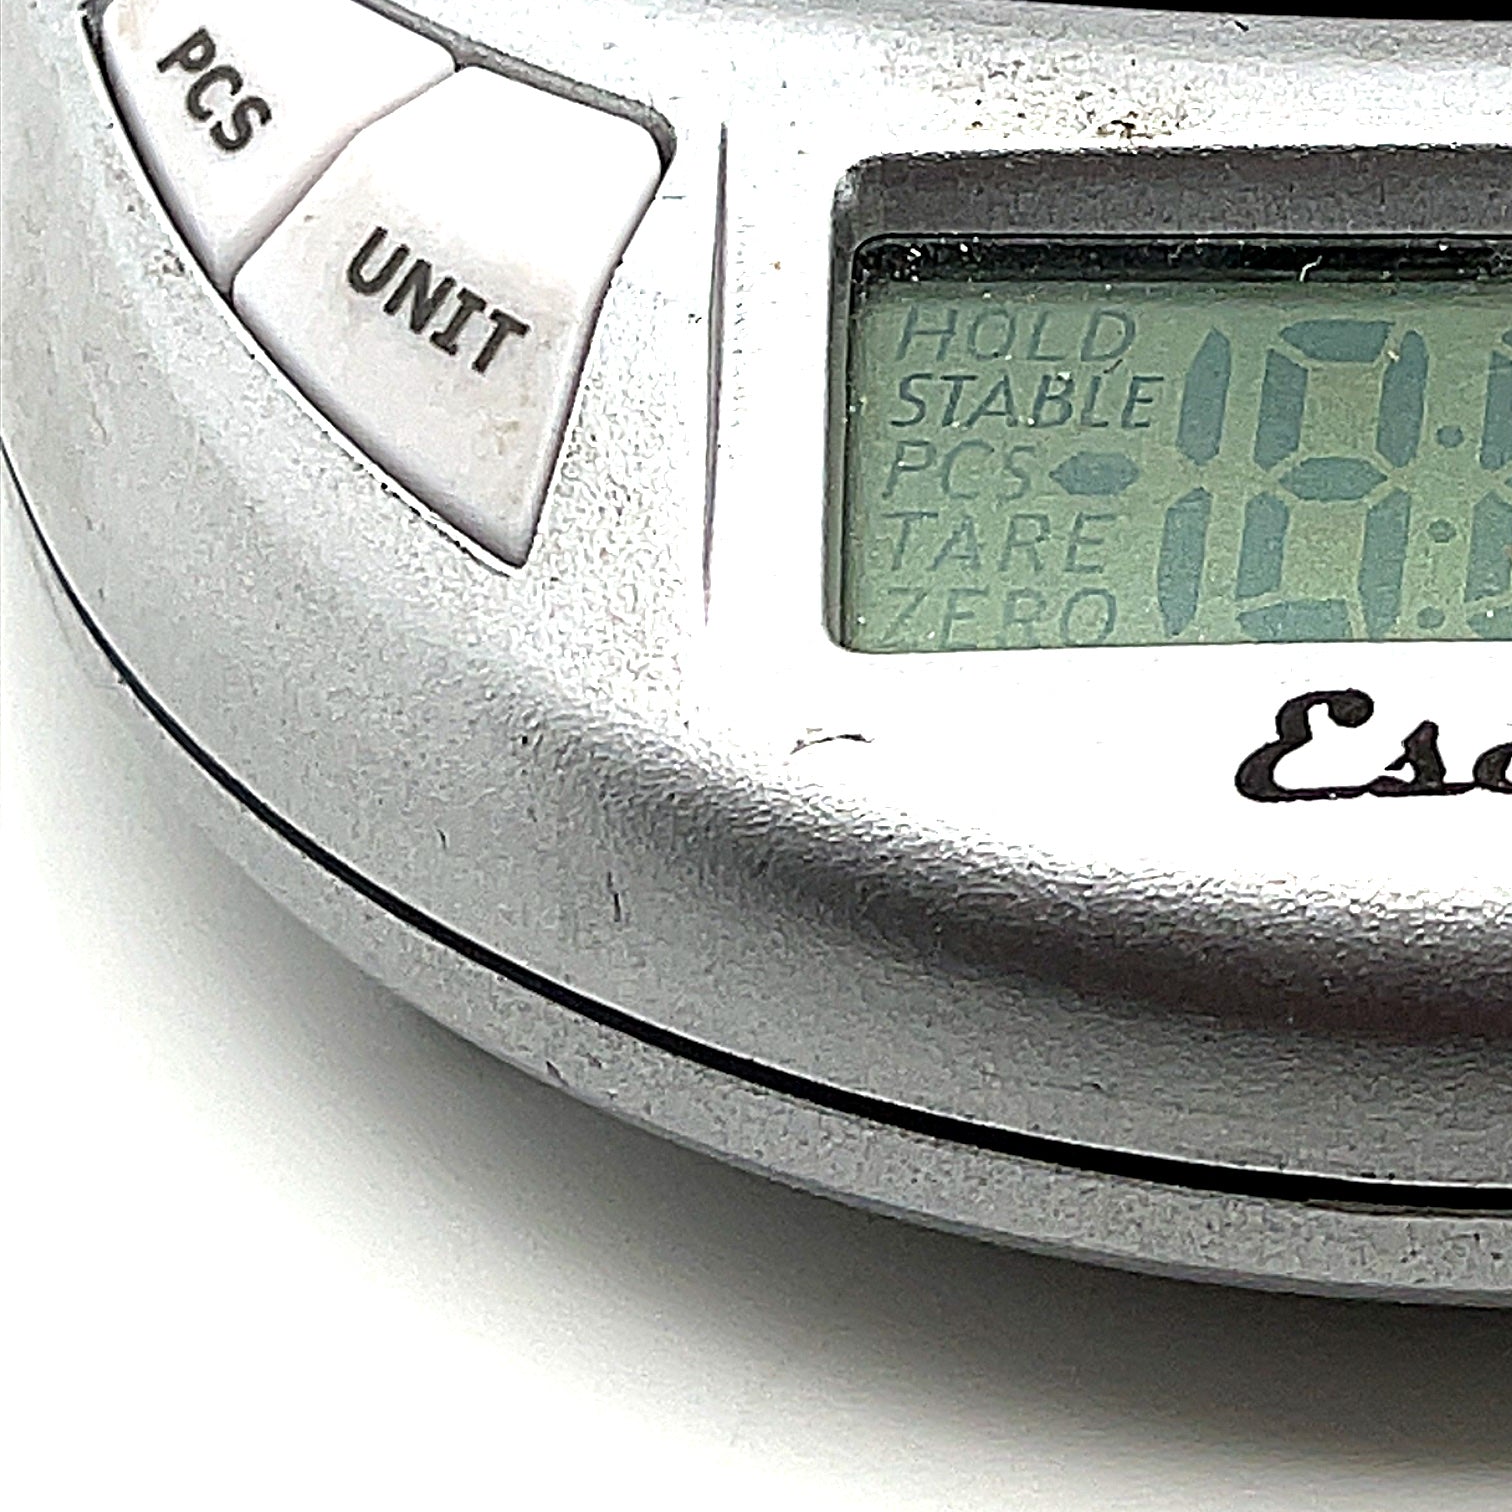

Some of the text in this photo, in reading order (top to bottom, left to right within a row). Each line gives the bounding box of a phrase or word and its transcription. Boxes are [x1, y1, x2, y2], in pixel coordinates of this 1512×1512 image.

[156, 28, 272, 153] PCS
[345, 225, 530, 374] UNIT
[900, 307, 1138, 363] HOLD
[889, 374, 1165, 430] STABLE
[881, 440, 1038, 500] PCS
[880, 510, 1119, 576] TARE
